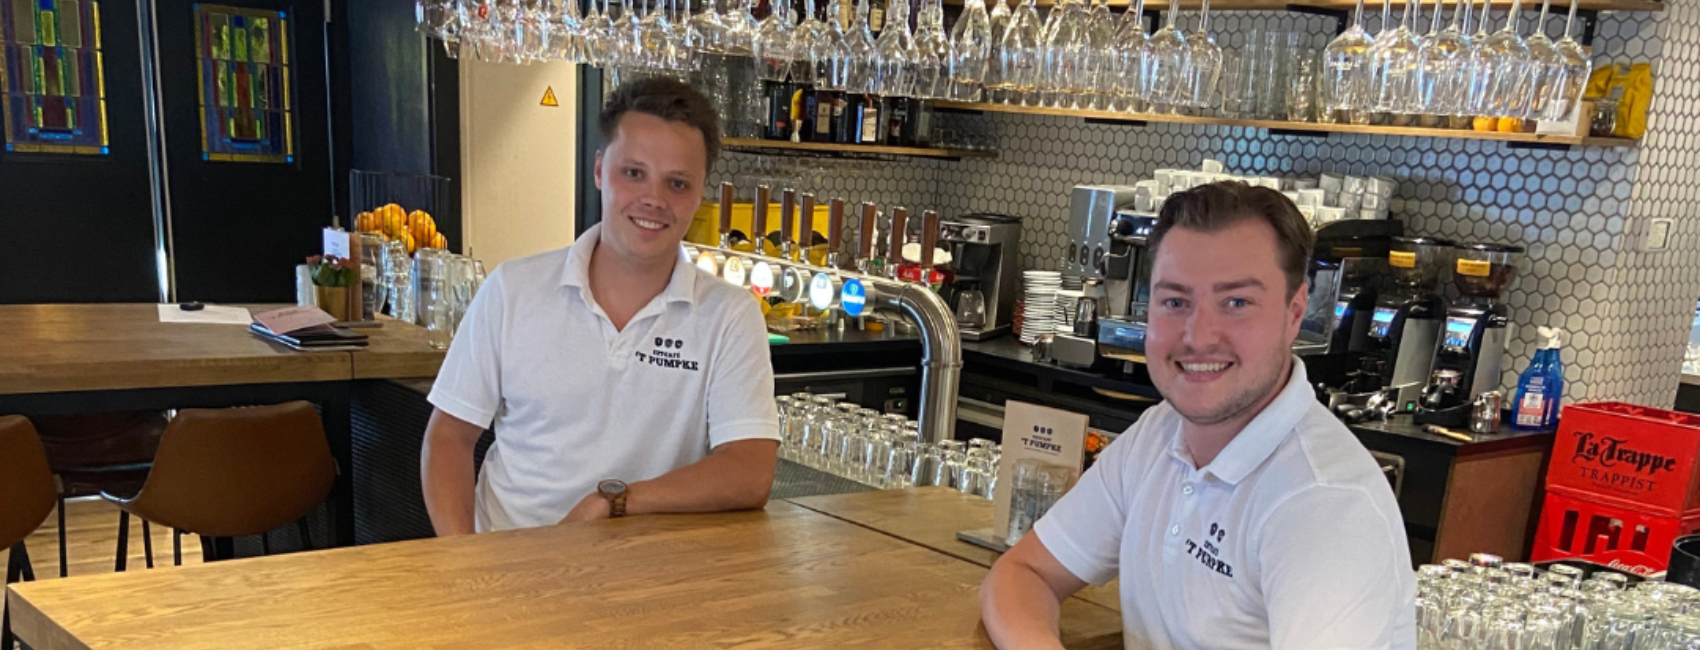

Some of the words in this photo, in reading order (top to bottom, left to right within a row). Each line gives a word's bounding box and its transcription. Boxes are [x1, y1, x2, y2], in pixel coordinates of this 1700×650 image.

[648, 355, 699, 371] PUMPKE
[1572, 431, 1599, 463] La
[1600, 436, 1676, 474] Trappe
[1581, 466, 1655, 491] TRAPPIST
